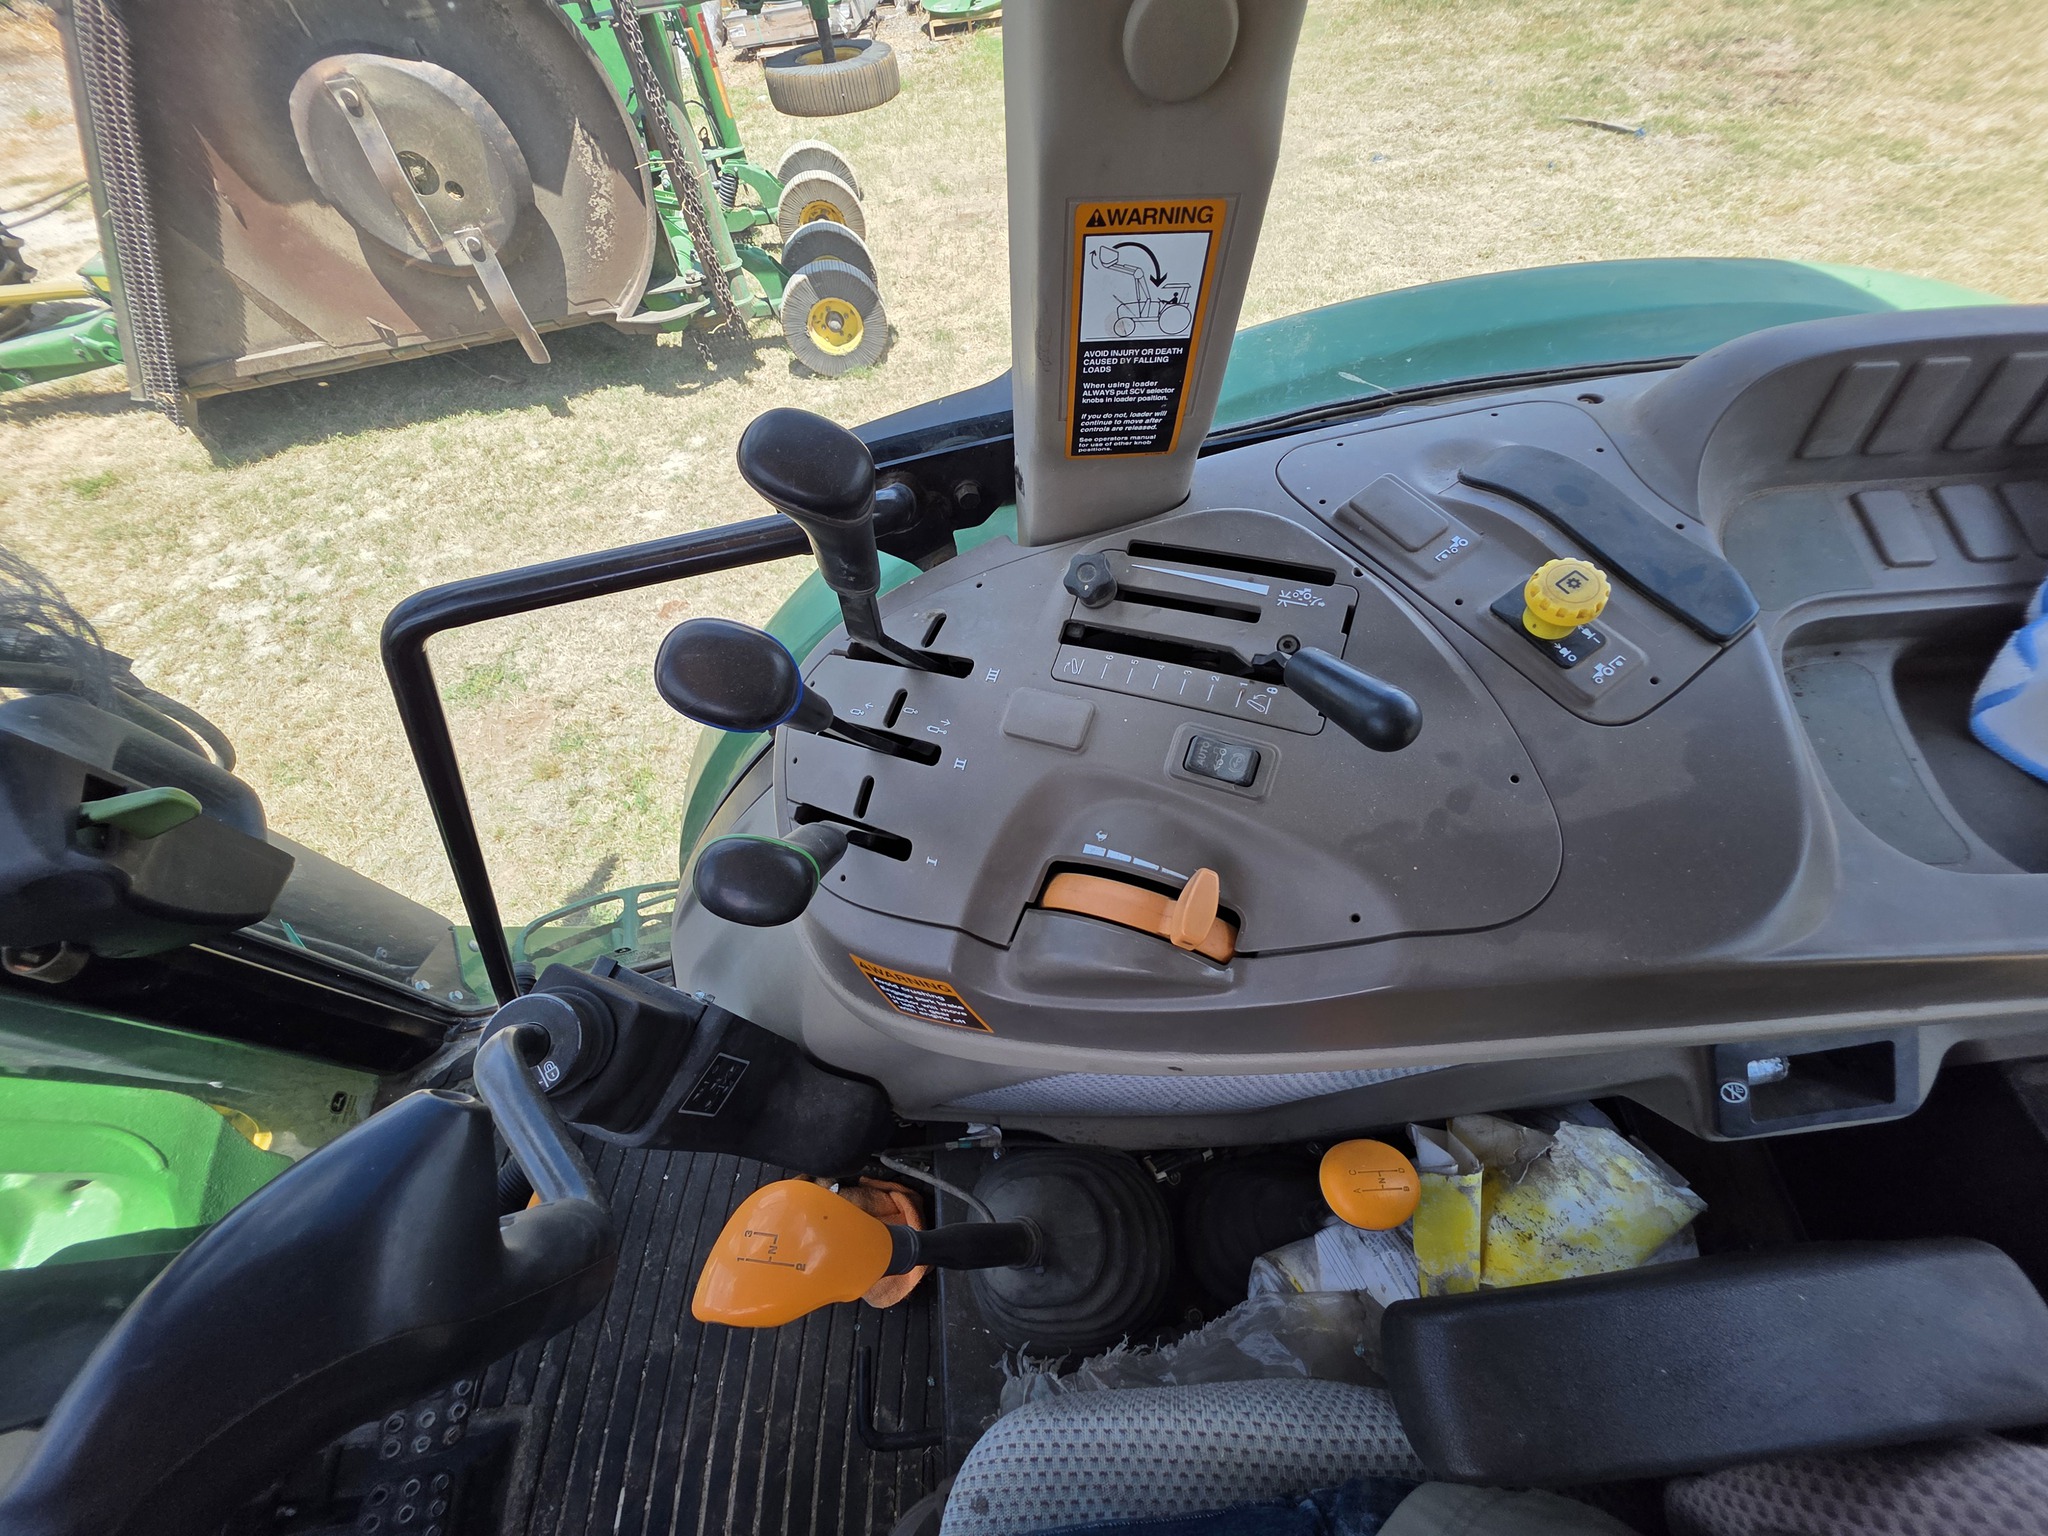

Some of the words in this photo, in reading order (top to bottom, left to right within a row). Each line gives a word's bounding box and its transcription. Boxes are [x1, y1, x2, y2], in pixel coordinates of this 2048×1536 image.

[1107, 205, 1214, 225] WARNING
[1084, 350, 1109, 358] AVOID
[1110, 349, 1140, 357] INJURY
[1133, 356, 1169, 364] FALLING
[1197, 741, 1210, 766] AUTO
[869, 966, 951, 992] WARNING
[768, 1246, 777, 1254] N
